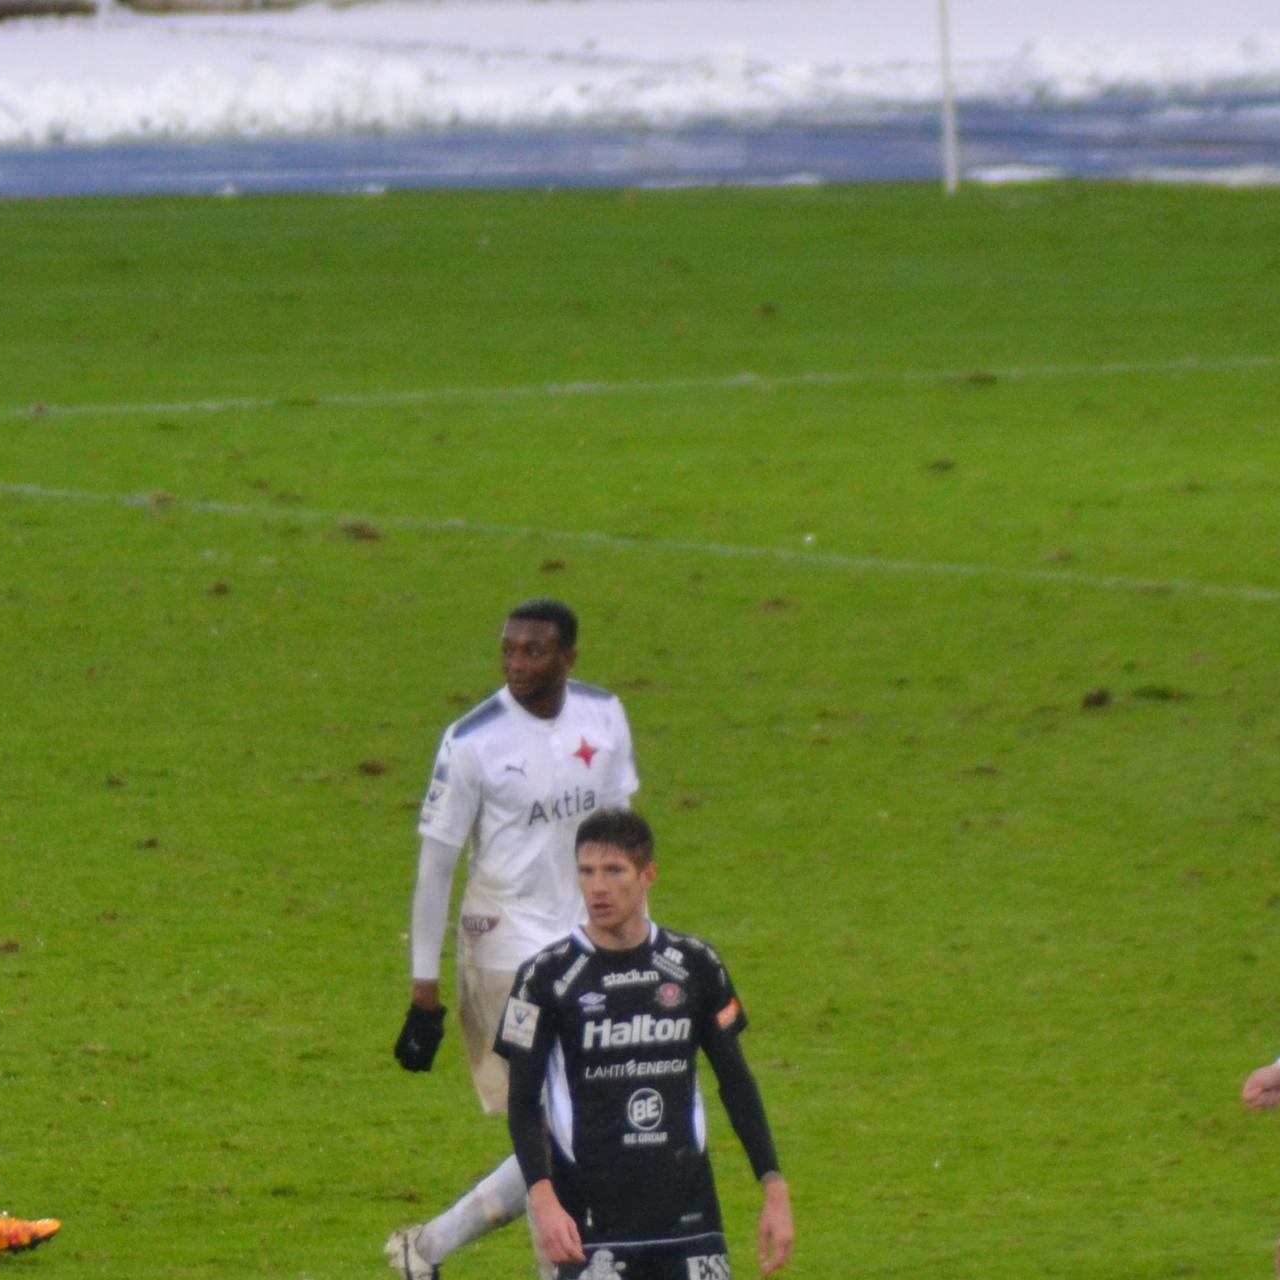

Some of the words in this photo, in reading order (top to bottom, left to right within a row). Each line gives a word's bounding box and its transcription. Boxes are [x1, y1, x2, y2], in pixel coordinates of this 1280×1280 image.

[528, 787, 596, 826] Aktia
[603, 969, 660, 988] stadium
[583, 1014, 691, 1049] Halton
[585, 1064, 625, 1079] LAHTI
[637, 1059, 688, 1076] ENERGIA
[632, 1094, 660, 1122] BE
